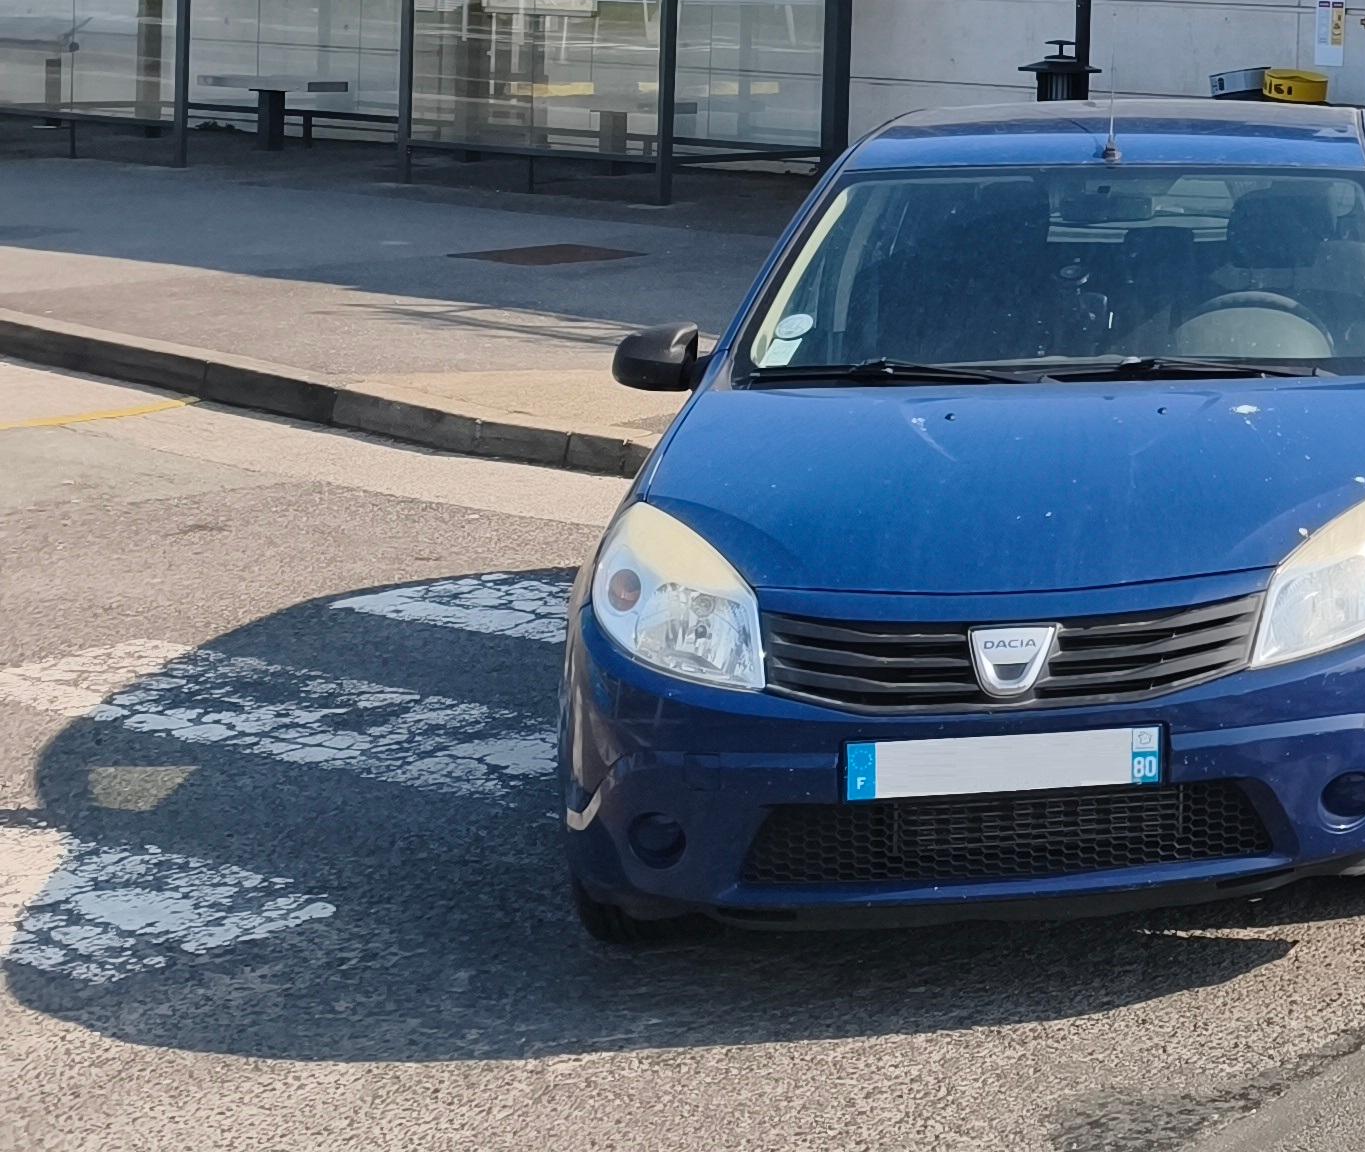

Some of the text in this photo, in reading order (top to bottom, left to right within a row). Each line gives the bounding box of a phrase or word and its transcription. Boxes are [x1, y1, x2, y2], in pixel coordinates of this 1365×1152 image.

[983, 639, 1037, 650] DACIA
[1133, 756, 1157, 778] 80
[856, 776, 867, 790] F
